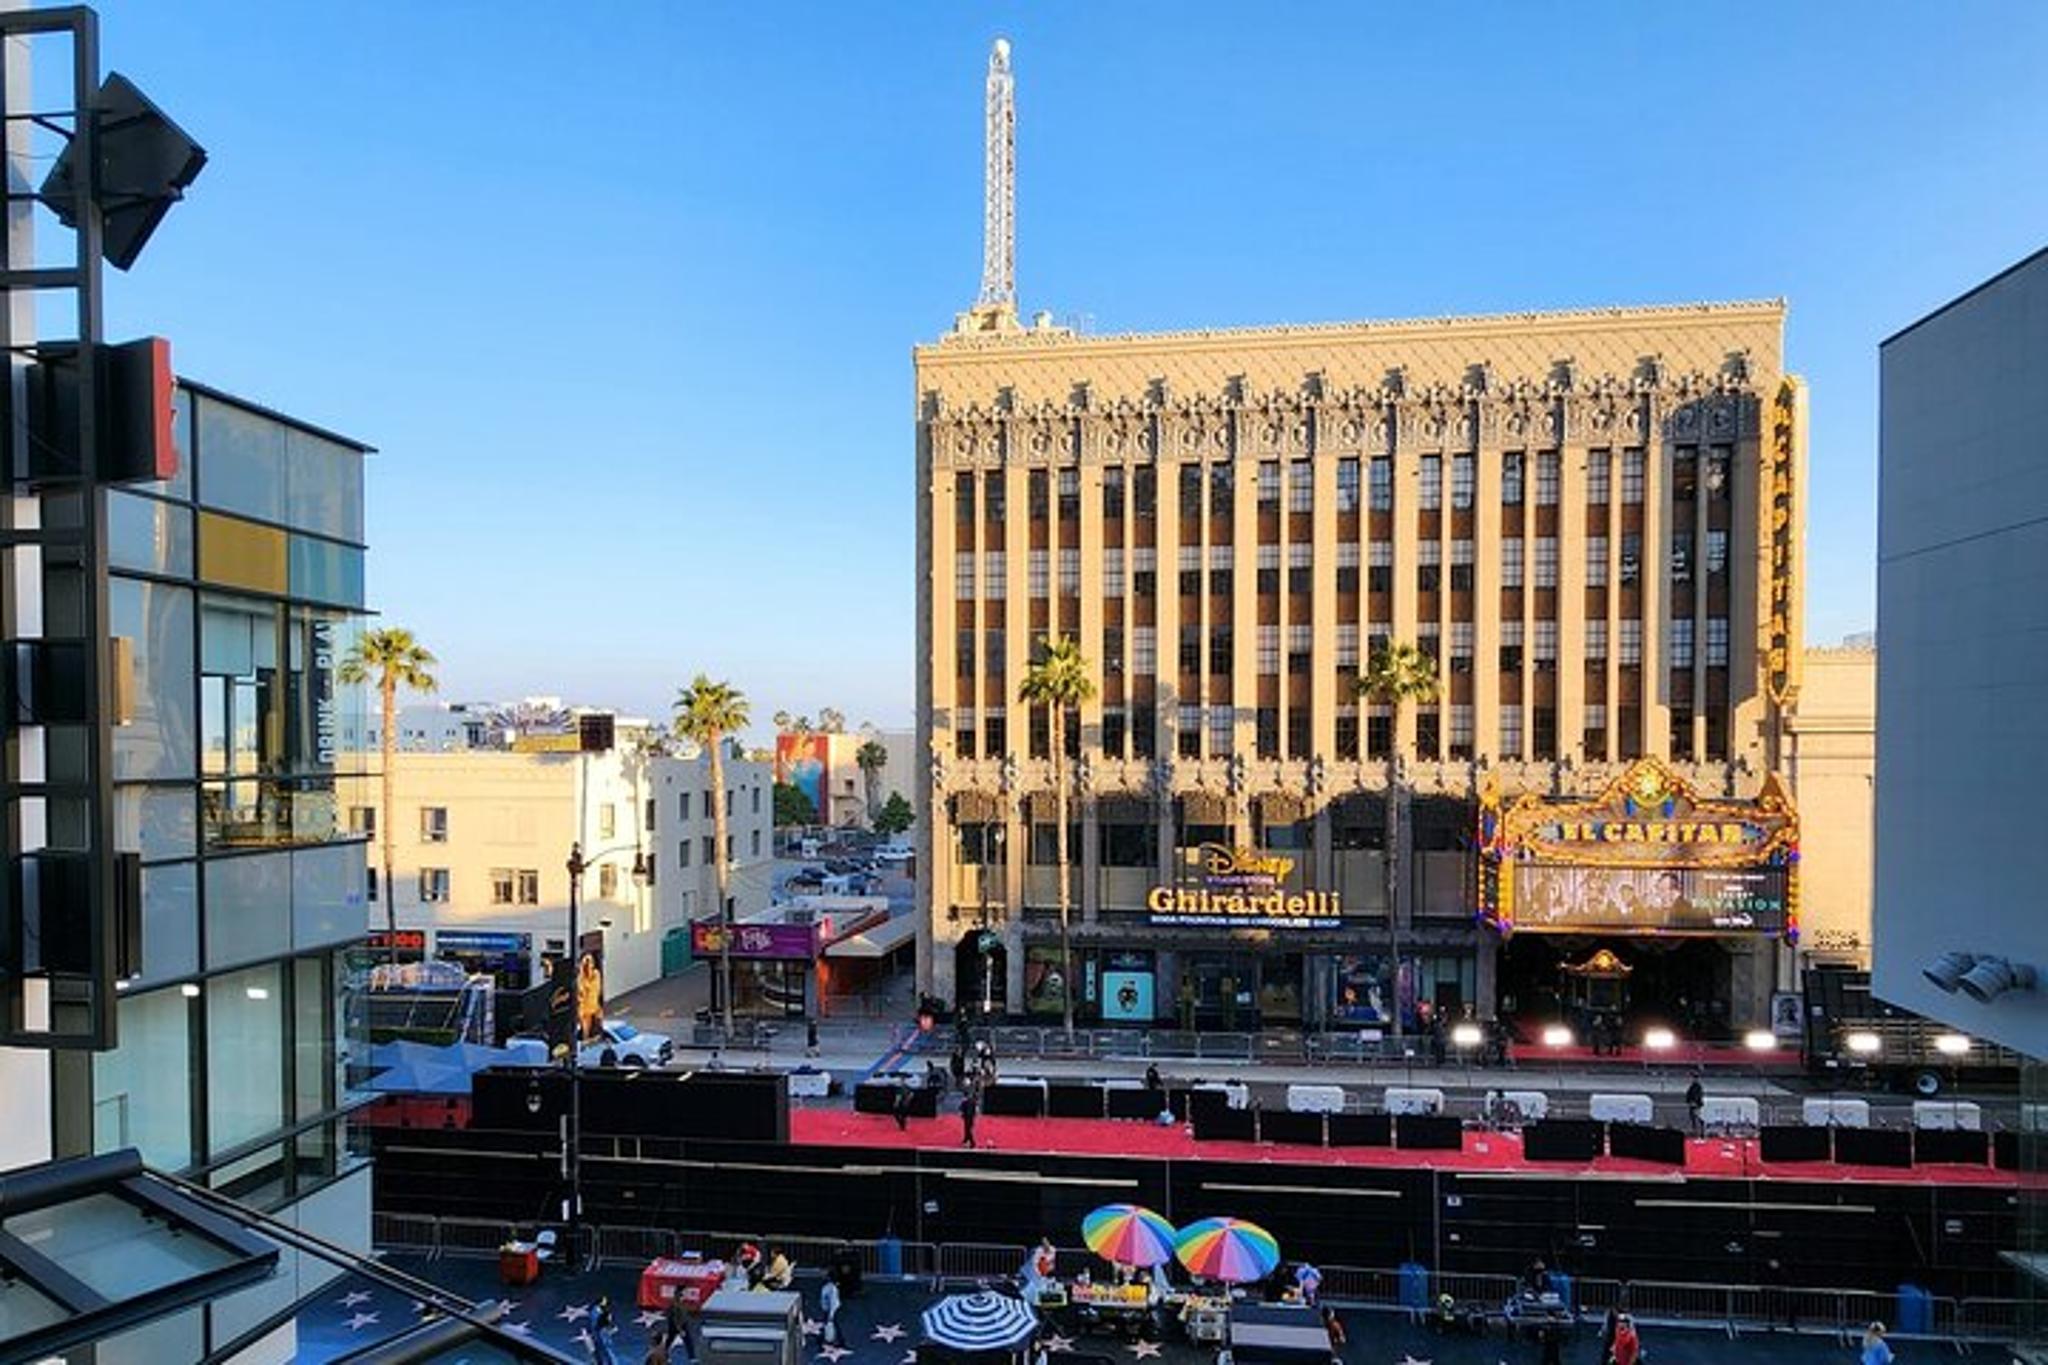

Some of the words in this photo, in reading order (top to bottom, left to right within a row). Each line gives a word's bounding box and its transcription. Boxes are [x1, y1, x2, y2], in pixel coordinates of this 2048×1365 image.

[1563, 822, 1596, 841] EL
[1603, 822, 1743, 843] CAPITAN
[1199, 841, 1296, 883] Disney
[1149, 886, 1341, 917] Ghirardelli
